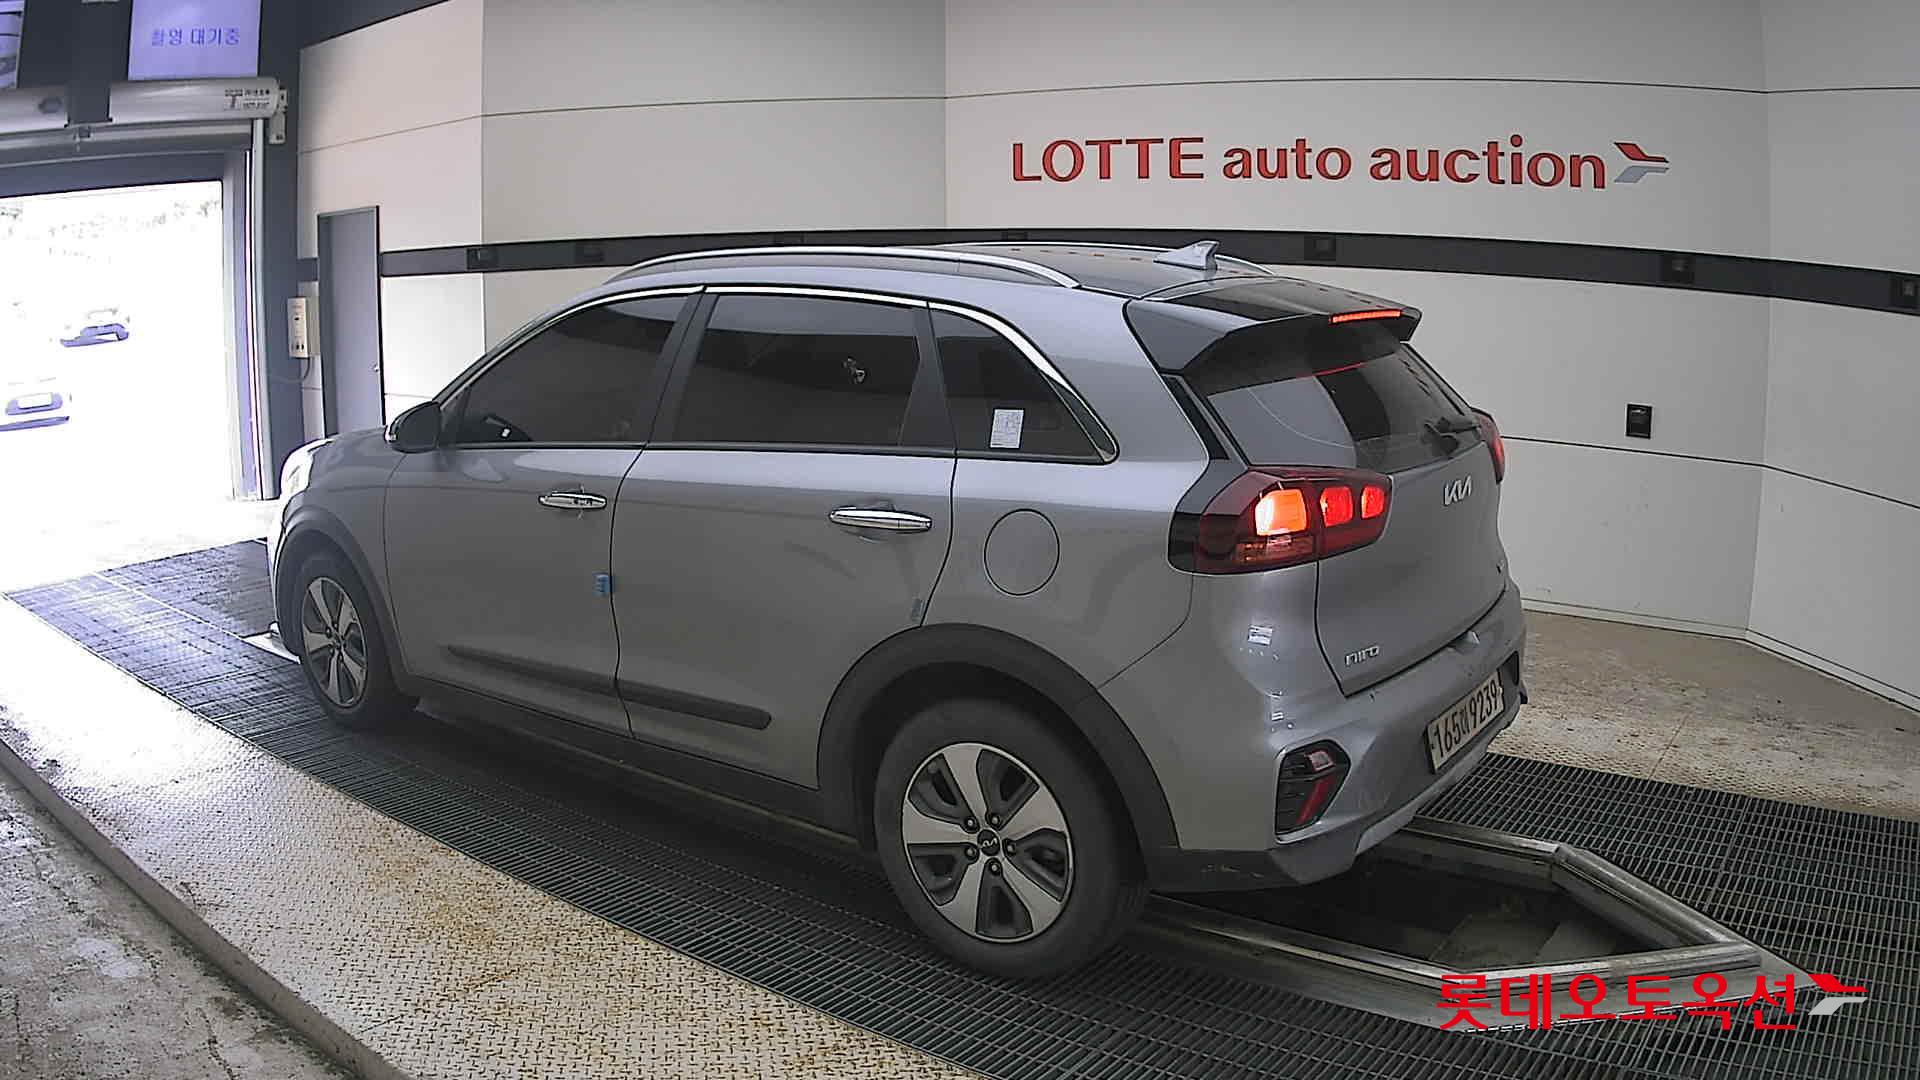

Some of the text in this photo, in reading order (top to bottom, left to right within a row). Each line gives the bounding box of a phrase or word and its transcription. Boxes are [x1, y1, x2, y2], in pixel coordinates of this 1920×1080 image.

[191, 28, 240, 46] 대기중
[1013, 135, 1605, 189] LOTTE auto auction
[1444, 475, 1472, 505] KIA
